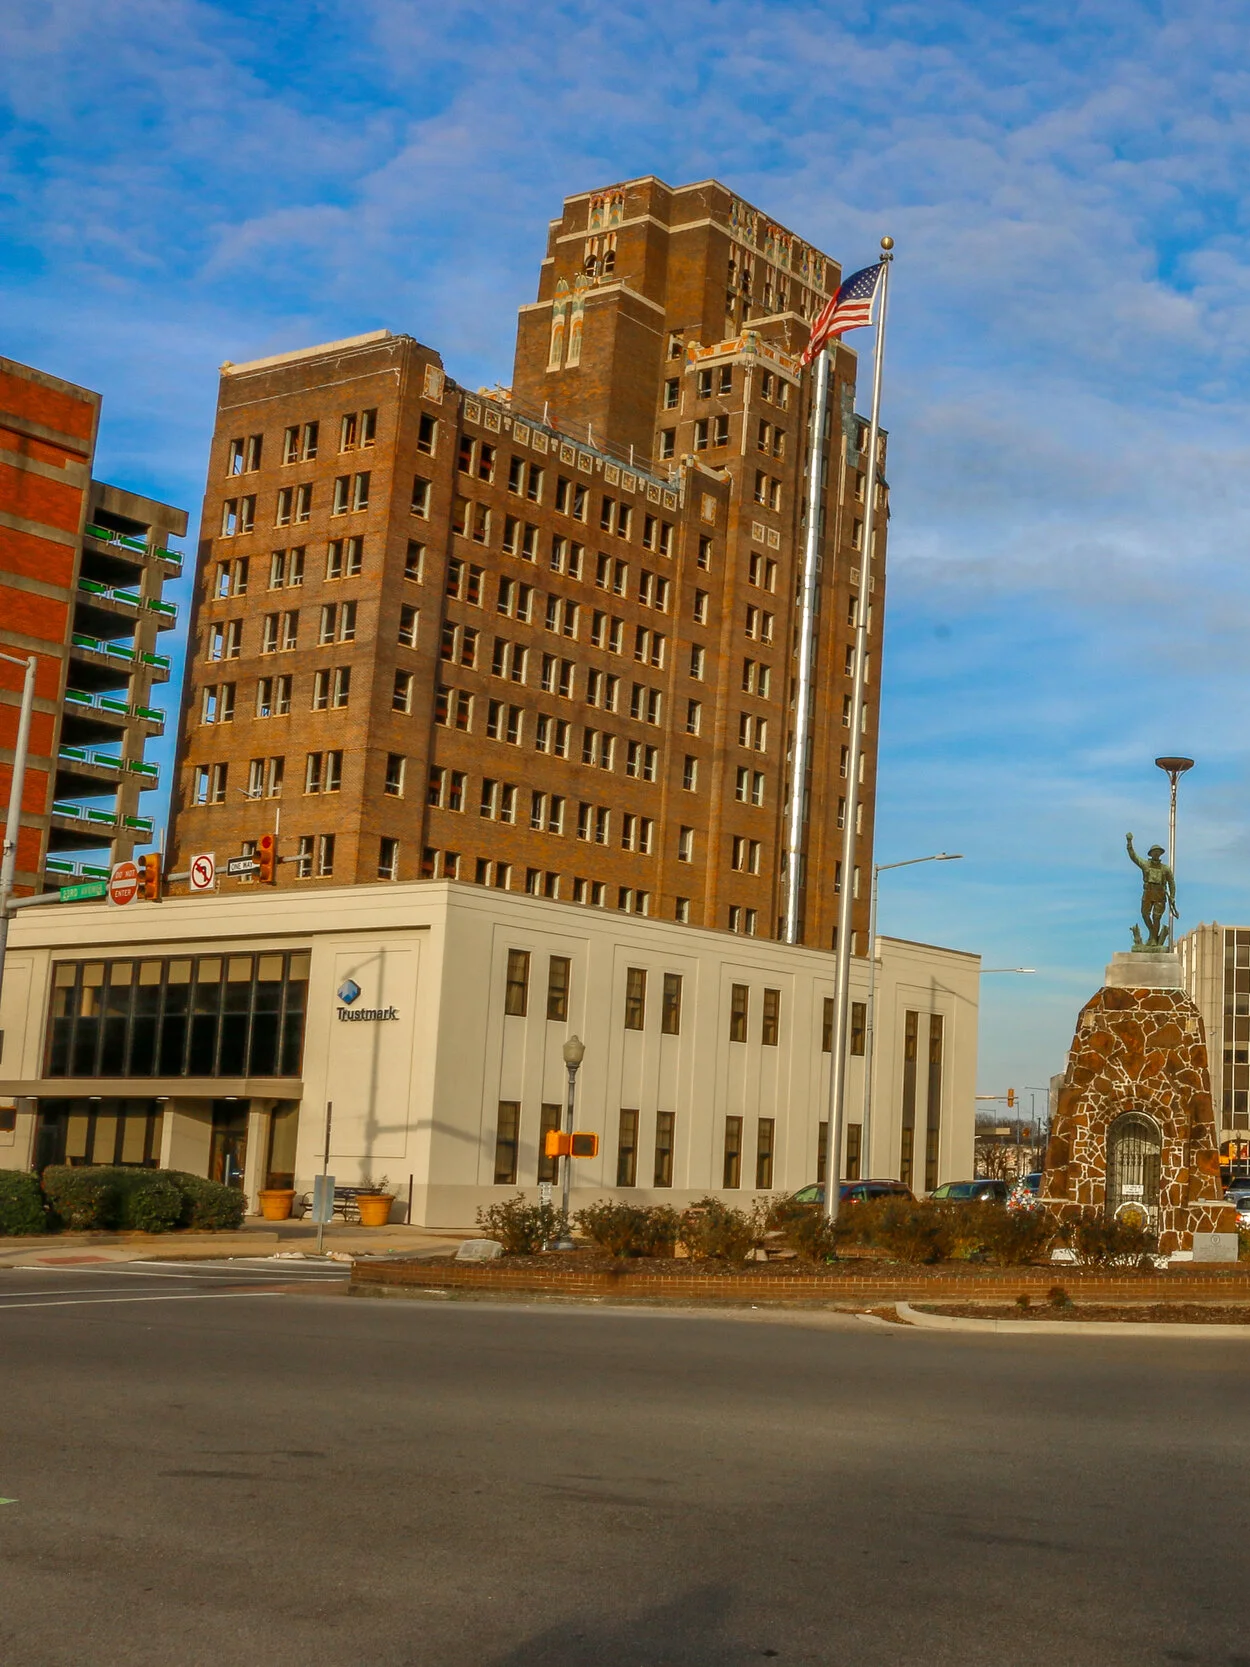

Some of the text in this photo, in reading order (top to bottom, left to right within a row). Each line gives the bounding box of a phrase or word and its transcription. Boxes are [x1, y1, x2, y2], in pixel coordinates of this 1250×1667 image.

[115, 869, 135, 879] DO NOT
[115, 889, 132, 897] ENTER
[337, 1006, 398, 1021] Trustmark
